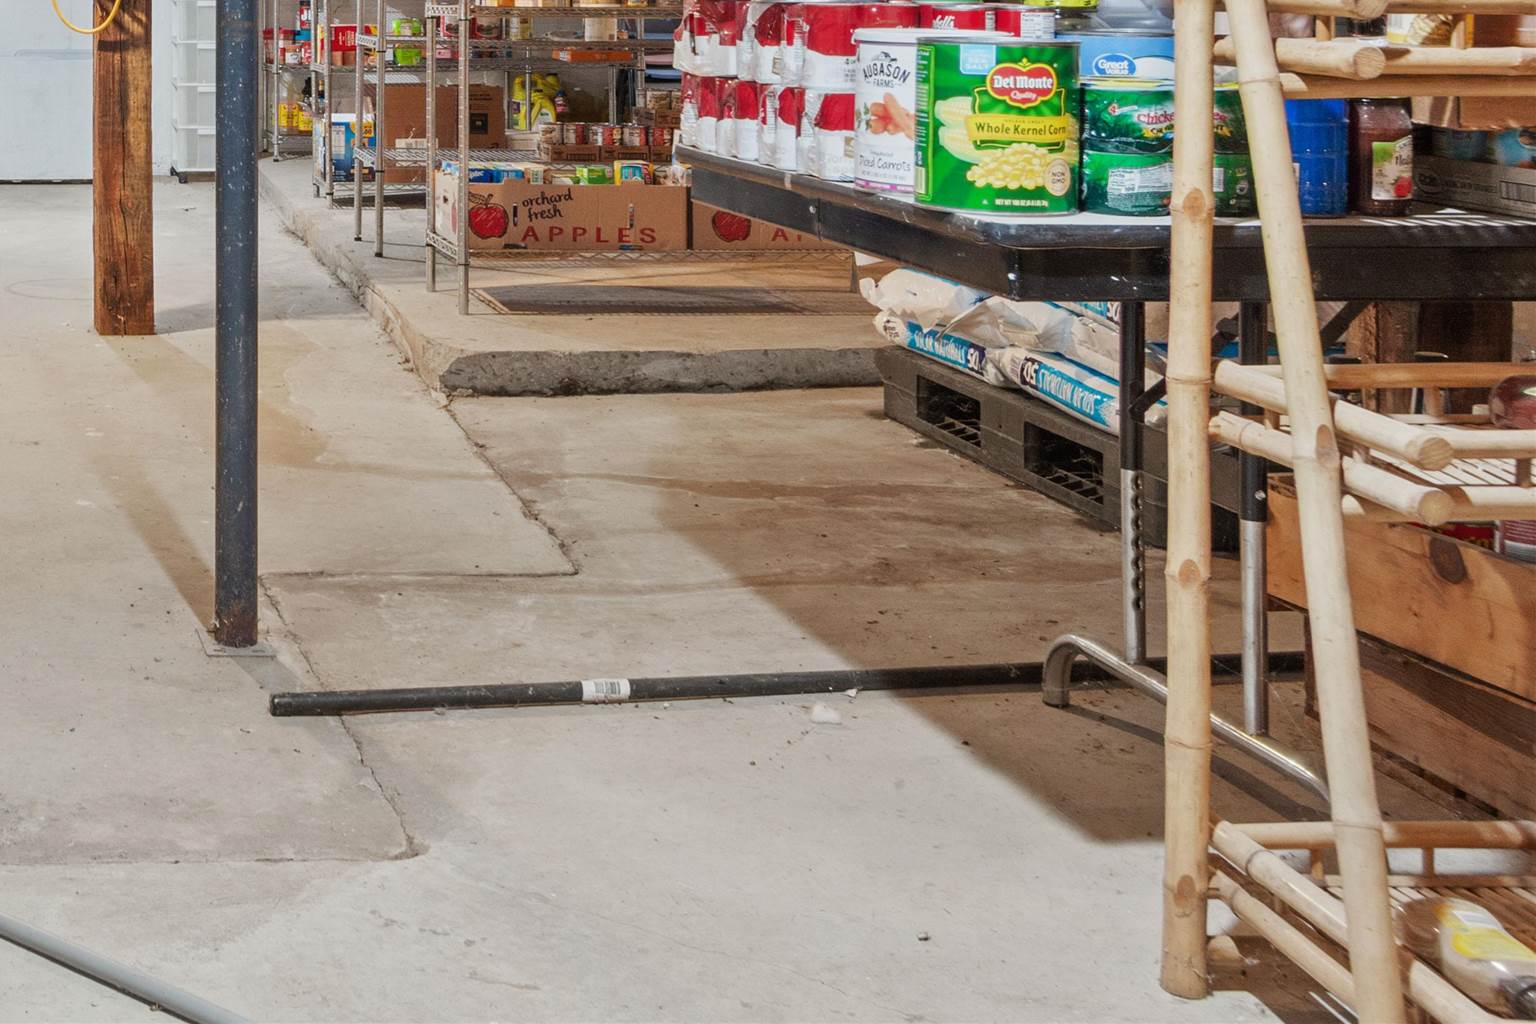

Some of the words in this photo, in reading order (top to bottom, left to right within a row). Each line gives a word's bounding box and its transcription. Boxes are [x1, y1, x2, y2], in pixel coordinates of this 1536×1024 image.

[1098, 59, 1128, 69] Great
[863, 63, 911, 84] AUGASON
[873, 79, 894, 88] FARMS
[992, 75, 1015, 89] Del
[1016, 75, 1053, 89] Monte
[1010, 90, 1037, 101] Quality
[975, 122, 1010, 134] Whole
[1013, 123, 1046, 136] Kernel
[877, 157, 911, 171] Carrots
[522, 188, 573, 208] orchard
[527, 207, 563, 222] fresh
[521, 226, 657, 244] APPLES
